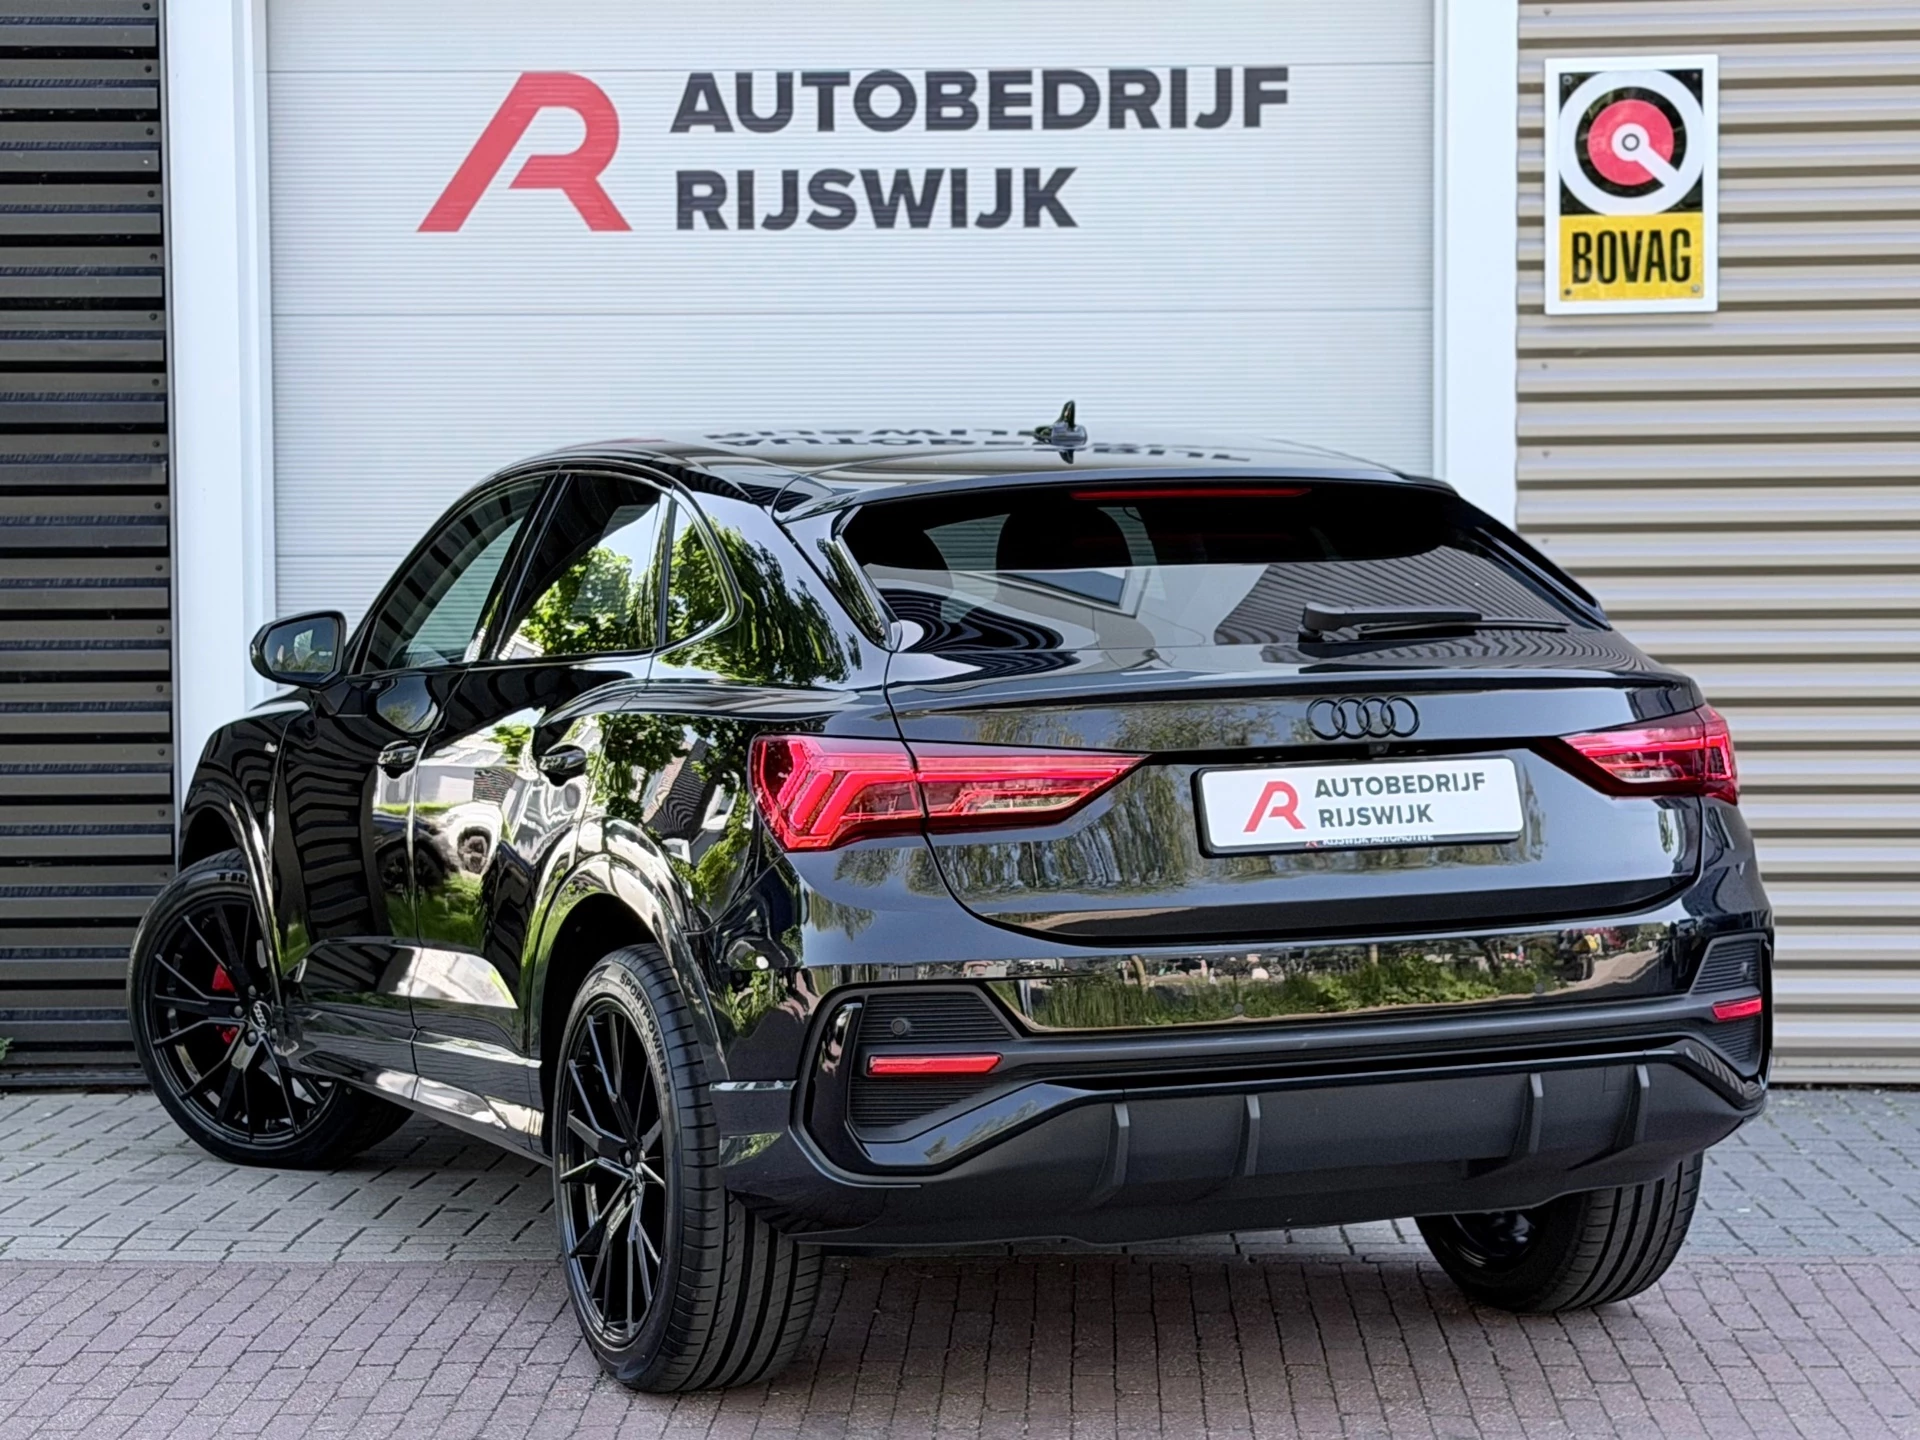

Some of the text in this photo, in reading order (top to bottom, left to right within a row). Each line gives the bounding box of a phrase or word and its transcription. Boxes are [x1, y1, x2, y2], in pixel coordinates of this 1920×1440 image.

[669, 66, 1289, 134] AUTOBEDRIJF
[675, 166, 1078, 231] RIJSWIJK
[1571, 228, 1691, 285] BOVAG
[1315, 772, 1486, 798] AUTOBEDRIJF
[1319, 803, 1434, 828] RIJSWIJK
[619, 973, 668, 1076] SPORTPOWER
